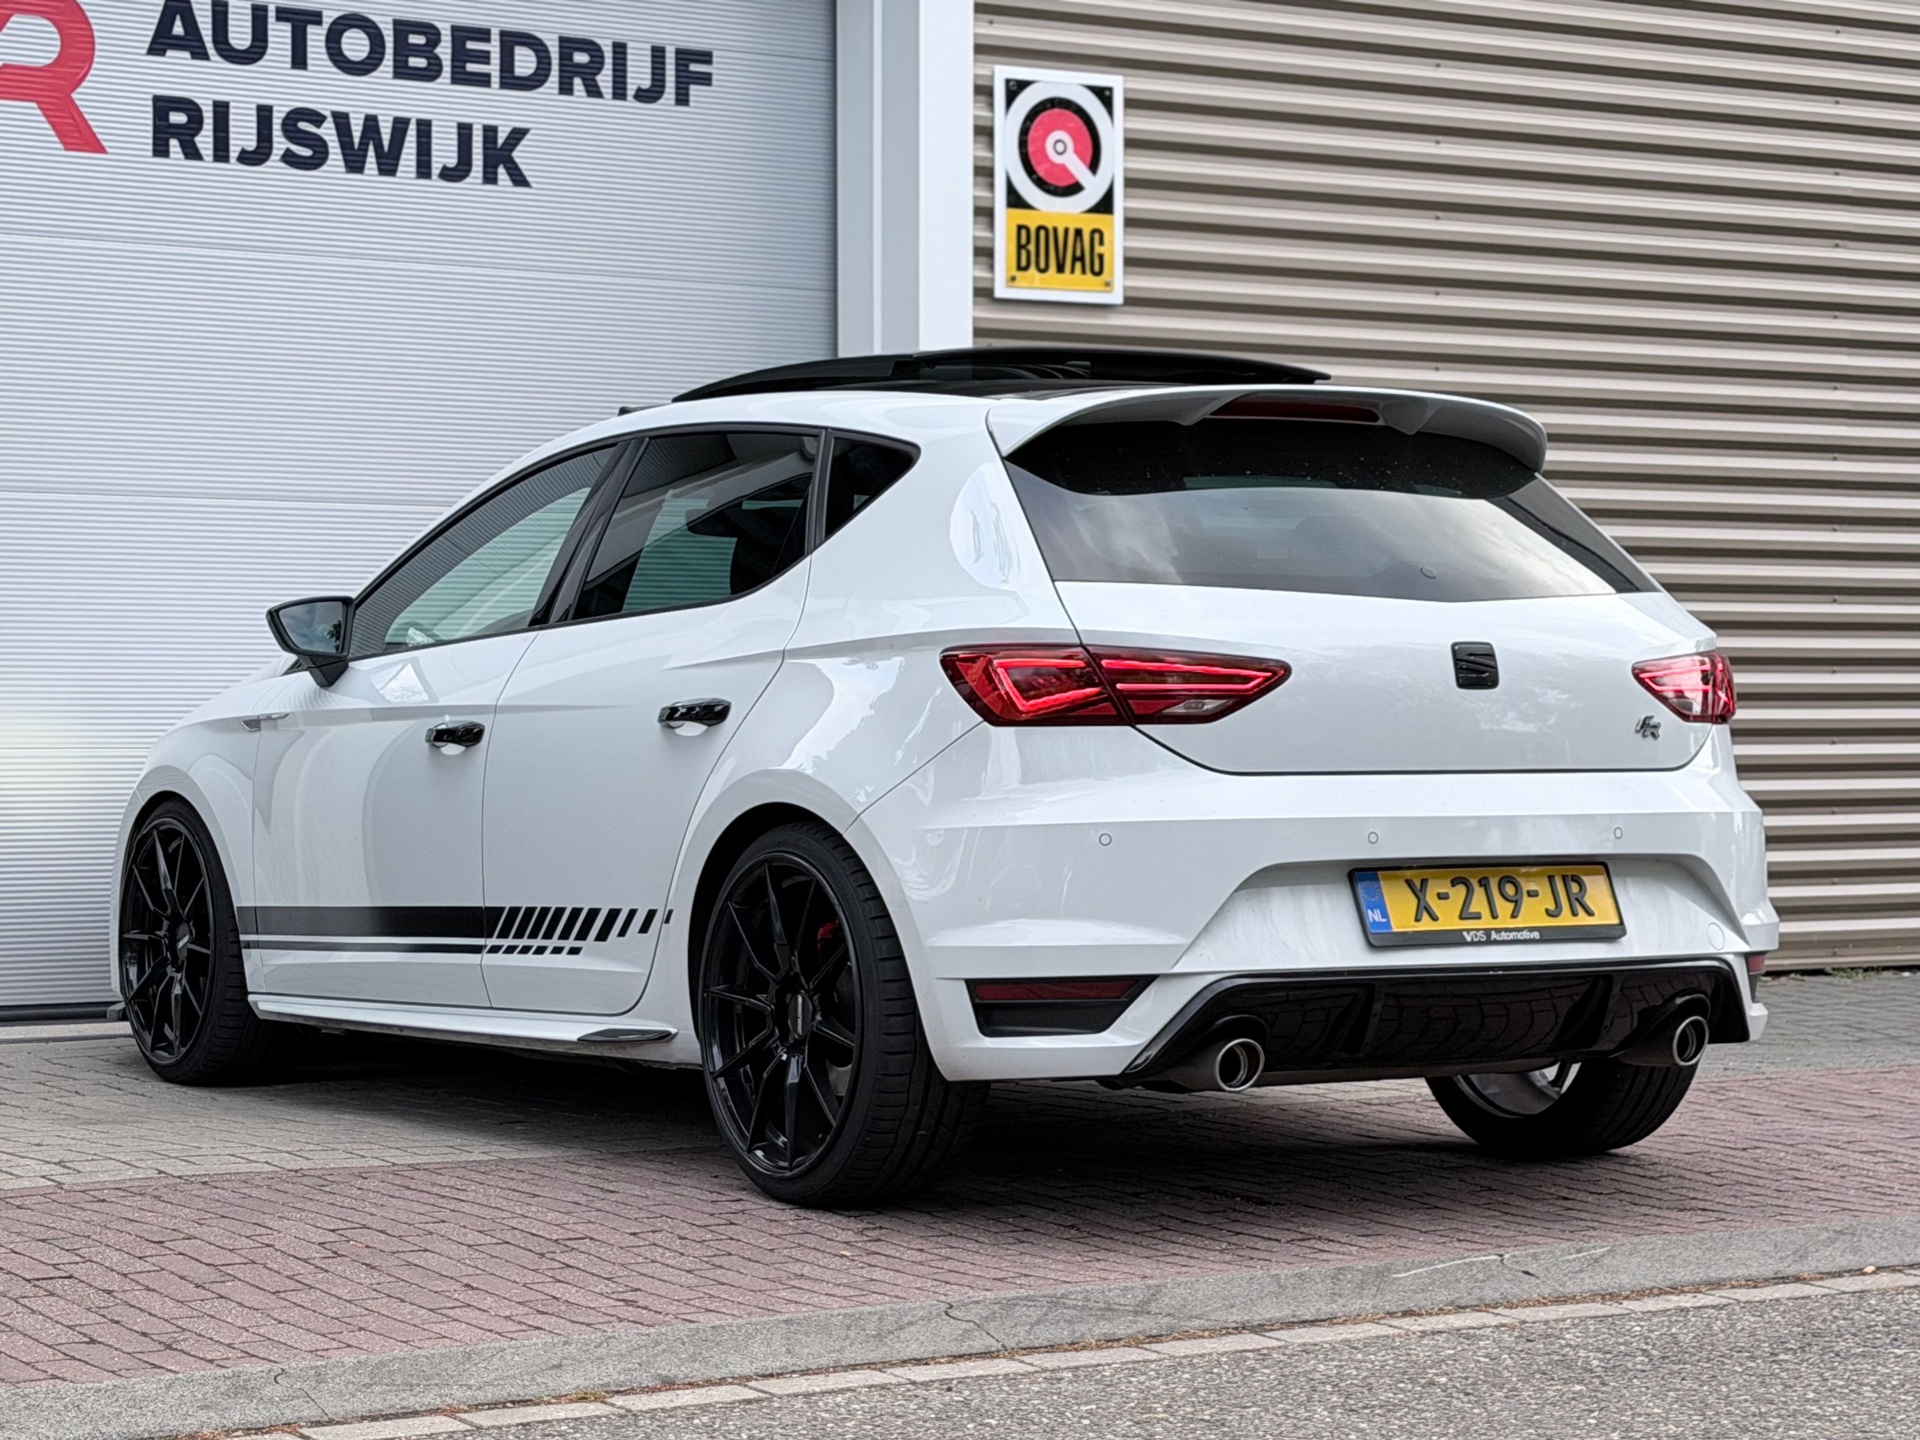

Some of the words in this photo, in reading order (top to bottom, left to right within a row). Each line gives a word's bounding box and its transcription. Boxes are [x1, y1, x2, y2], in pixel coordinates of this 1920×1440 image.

[146, 0, 713, 107] AUTOBEDRIJF
[152, 94, 532, 189] RIJSWIJK
[1015, 223, 1105, 277] BOVAG
[1367, 909, 1388, 923] NL
[1405, 874, 1595, 922] X-219-JR
[1462, 930, 1487, 942] VDS
[1490, 929, 1540, 941] Automotive
